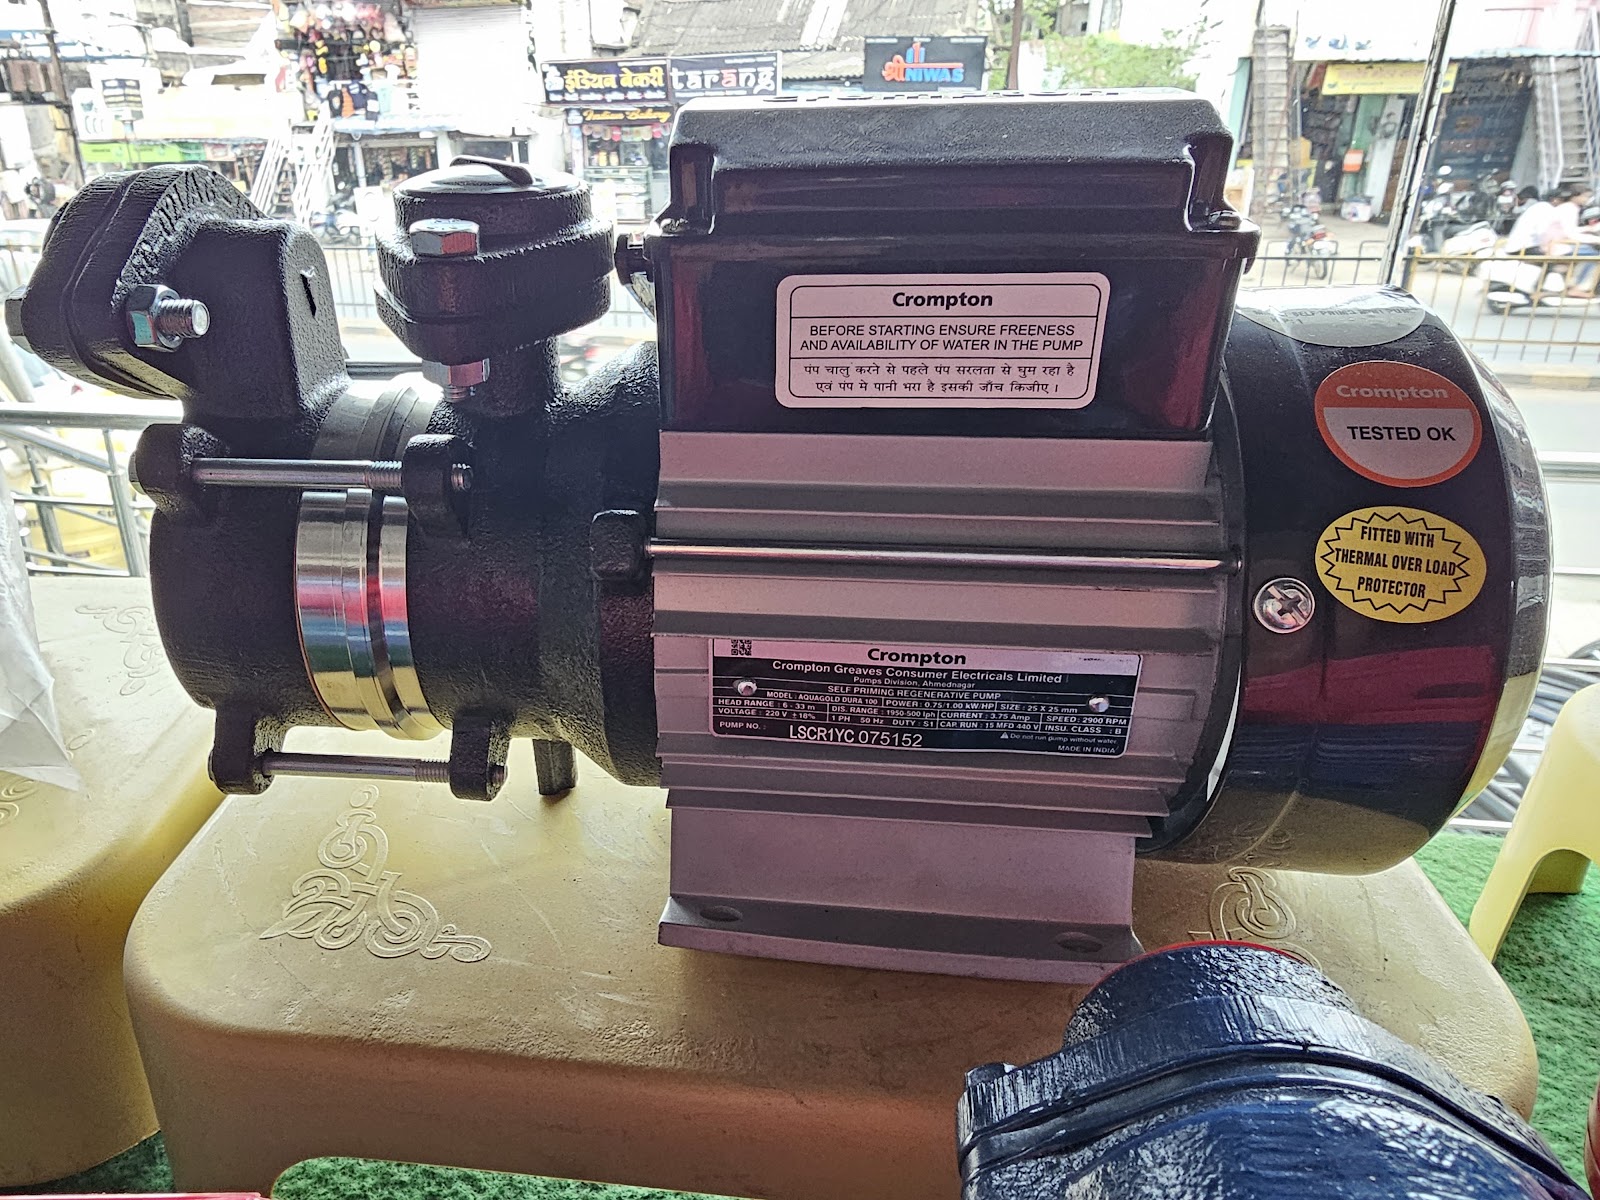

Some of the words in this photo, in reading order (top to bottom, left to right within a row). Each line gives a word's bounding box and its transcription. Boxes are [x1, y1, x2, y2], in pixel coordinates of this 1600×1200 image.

[670, 66, 775, 95] tarang
[905, 68, 964, 82] NIWAS
[892, 292, 993, 310] Crompton
[810, 325, 865, 336] BEFORE
[868, 324, 935, 336] STARTING
[939, 324, 996, 336] ENSURE
[1000, 324, 1075, 336] FREENESS
[800, 340, 828, 350] AND
[831, 339, 917, 351] AVAILABILITY
[920, 340, 939, 350] OF
[943, 340, 990, 350] WATER
[994, 340, 1007, 350] IN
[1011, 340, 1039, 350] THE
[1042, 340, 1083, 350] PUMP
[804, 364, 820, 375] पंप
[855, 363, 880, 375] करने
[886, 363, 896, 375] से
[902, 363, 928, 376] पहले
[934, 364, 950, 375] पंप
[956, 366, 995, 375] सरलता
[1001, 363, 1011, 375] से
[1017, 366, 1037, 378] घुम
[1042, 366, 1060, 376] रहा
[1066, 363, 1075, 376] है
[816, 381, 833, 393] एवं
[838, 381, 854, 392] पंप
[874, 380, 897, 391] पानी
[903, 382, 921, 392] भरा
[927, 379, 935, 392] है
[941, 380, 973, 392] इसकी
[979, 380, 1004, 392] जाँच
[1010, 380, 1049, 394] किजीए
[1336, 384, 1449, 401] Crompton
[1347, 425, 1421, 441] TESTED
[1427, 426, 1456, 441] OK
[1360, 525, 1401, 544] FITTED
[1405, 530, 1435, 548] WITH
[1335, 547, 1388, 568] THERMAL
[1392, 554, 1422, 572] OVER
[1425, 558, 1456, 577] LOAD
[1357, 576, 1426, 599] PROTECTOR
[867, 648, 966, 667] Crompton
[772, 660, 831, 675] Crompton
[834, 664, 882, 676] Greaves
[886, 668, 948, 679] Consumer
[951, 670, 1013, 681] Electricals
[1017, 673, 1063, 684] Limited
[853, 676, 882, 685] Pumps
[922, 681, 975, 689] Ahmednagar
[767, 691, 793, 699] MODEL
[798, 693, 840, 703] AQUAGOLD
[842, 696, 863, 704] DURA
[828, 685, 851, 694] SELF
[854, 687, 894, 696] PRIMING
[897, 689, 970, 699] REGENERATIVE
[972, 692, 1001, 700] PUMP
[744, 700, 774, 708] RANGE
[832, 705, 849, 713] DIS.
[965, 702, 994, 710] kW/HP
[718, 708, 757, 716] VOLTAGE
[940, 711, 984, 719] CURRENT
[1010, 713, 1030, 722] Amp
[719, 721, 744, 729] PUMP
[746, 722, 761, 730] NO.
[873, 717, 884, 725] Hz
[923, 720, 934, 728] S1
[1082, 716, 1103, 724] 2900
[1105, 717, 1127, 725] RPM
[1071, 726, 1102, 734] CLASS
[858, 730, 923, 747] 075152
[1070, 736, 1096, 744] without
[1093, 746, 1116, 754] INDIA
